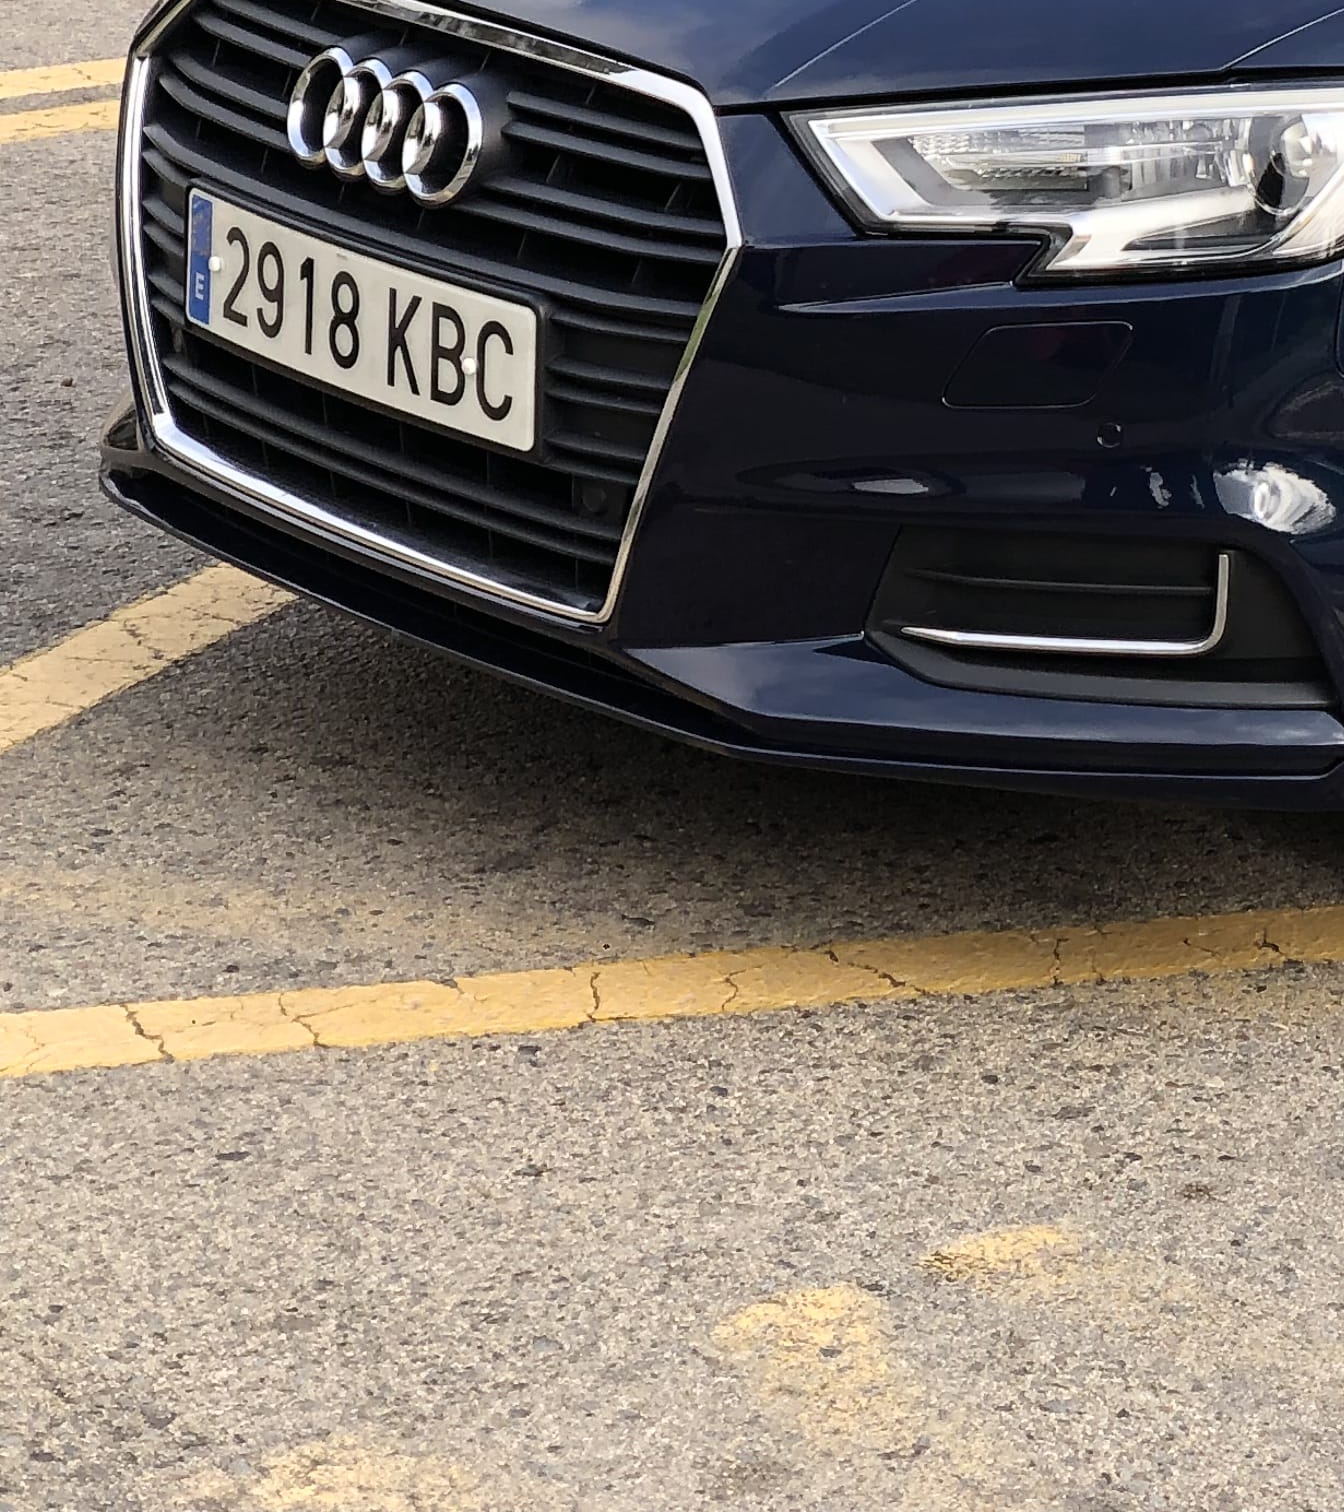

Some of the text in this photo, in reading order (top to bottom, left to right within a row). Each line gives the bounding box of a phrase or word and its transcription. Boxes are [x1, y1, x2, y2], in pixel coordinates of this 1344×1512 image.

[194, 272, 204, 300] E
[223, 226, 514, 421] 2918 KBC
